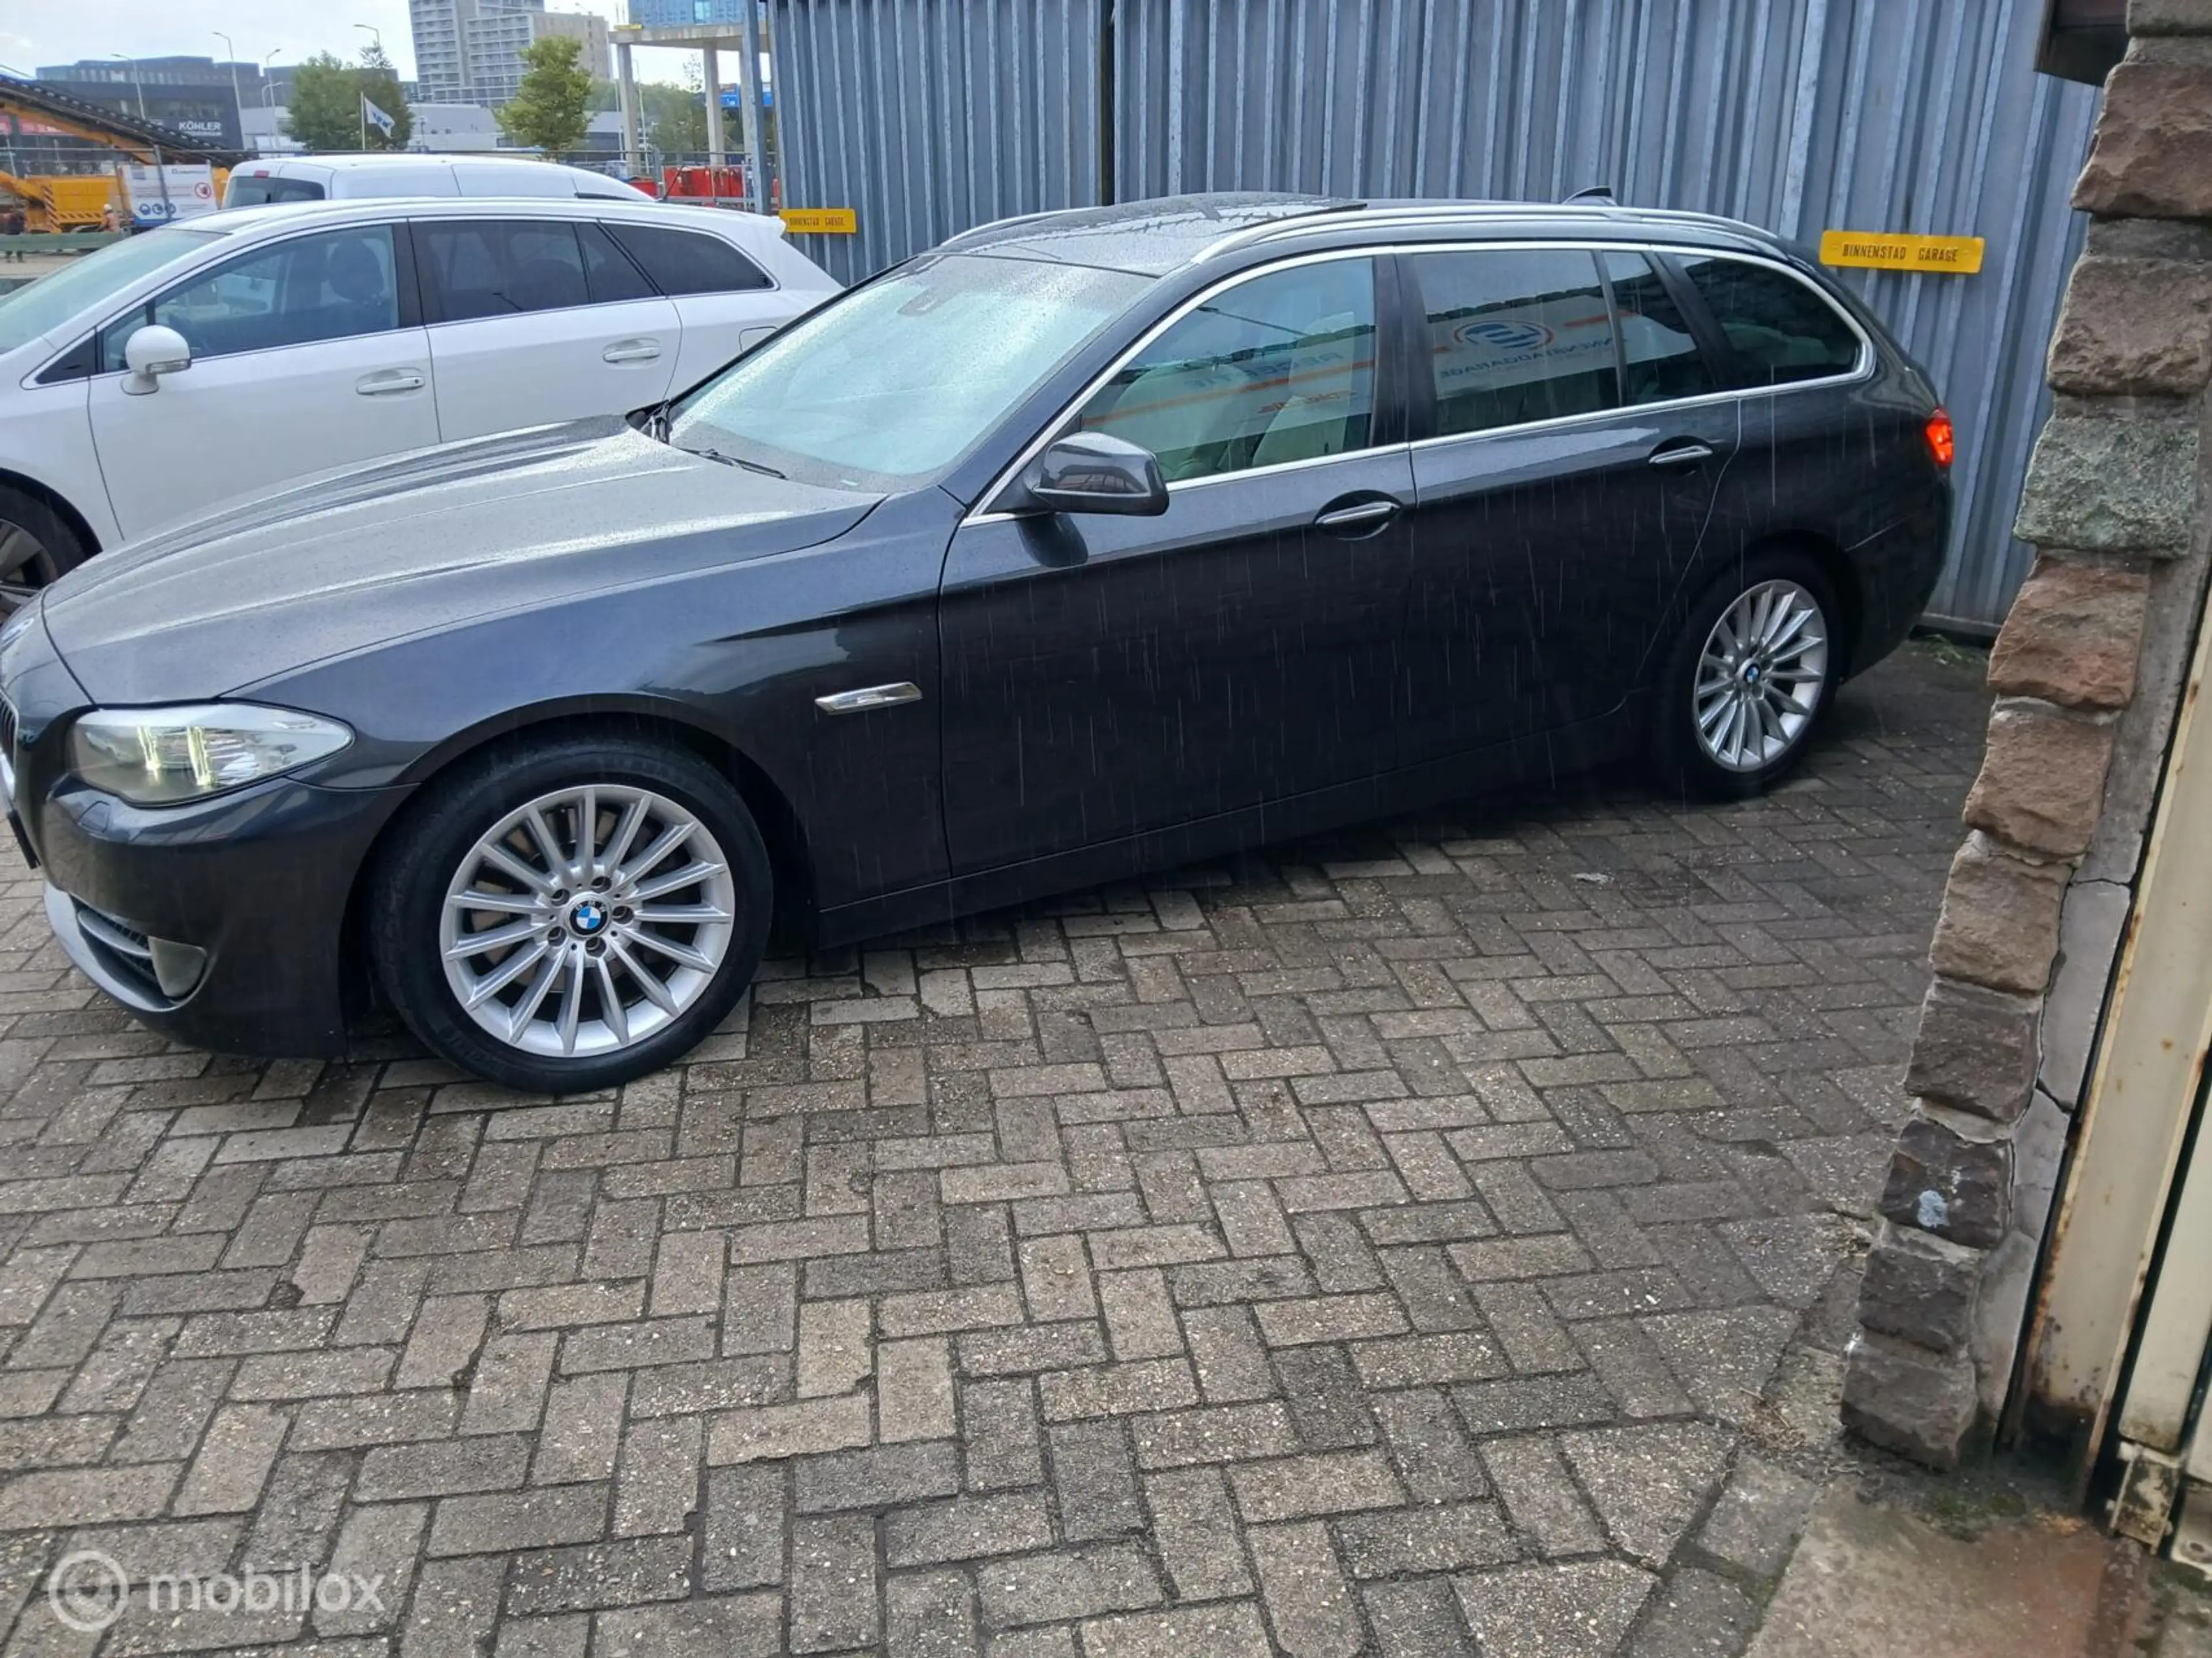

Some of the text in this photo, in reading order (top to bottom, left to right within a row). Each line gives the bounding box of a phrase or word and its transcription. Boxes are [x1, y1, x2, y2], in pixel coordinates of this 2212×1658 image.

[179, 120, 221, 131] KÖHLER
[1843, 243, 1958, 262] BINNENSTAD GARAGE
